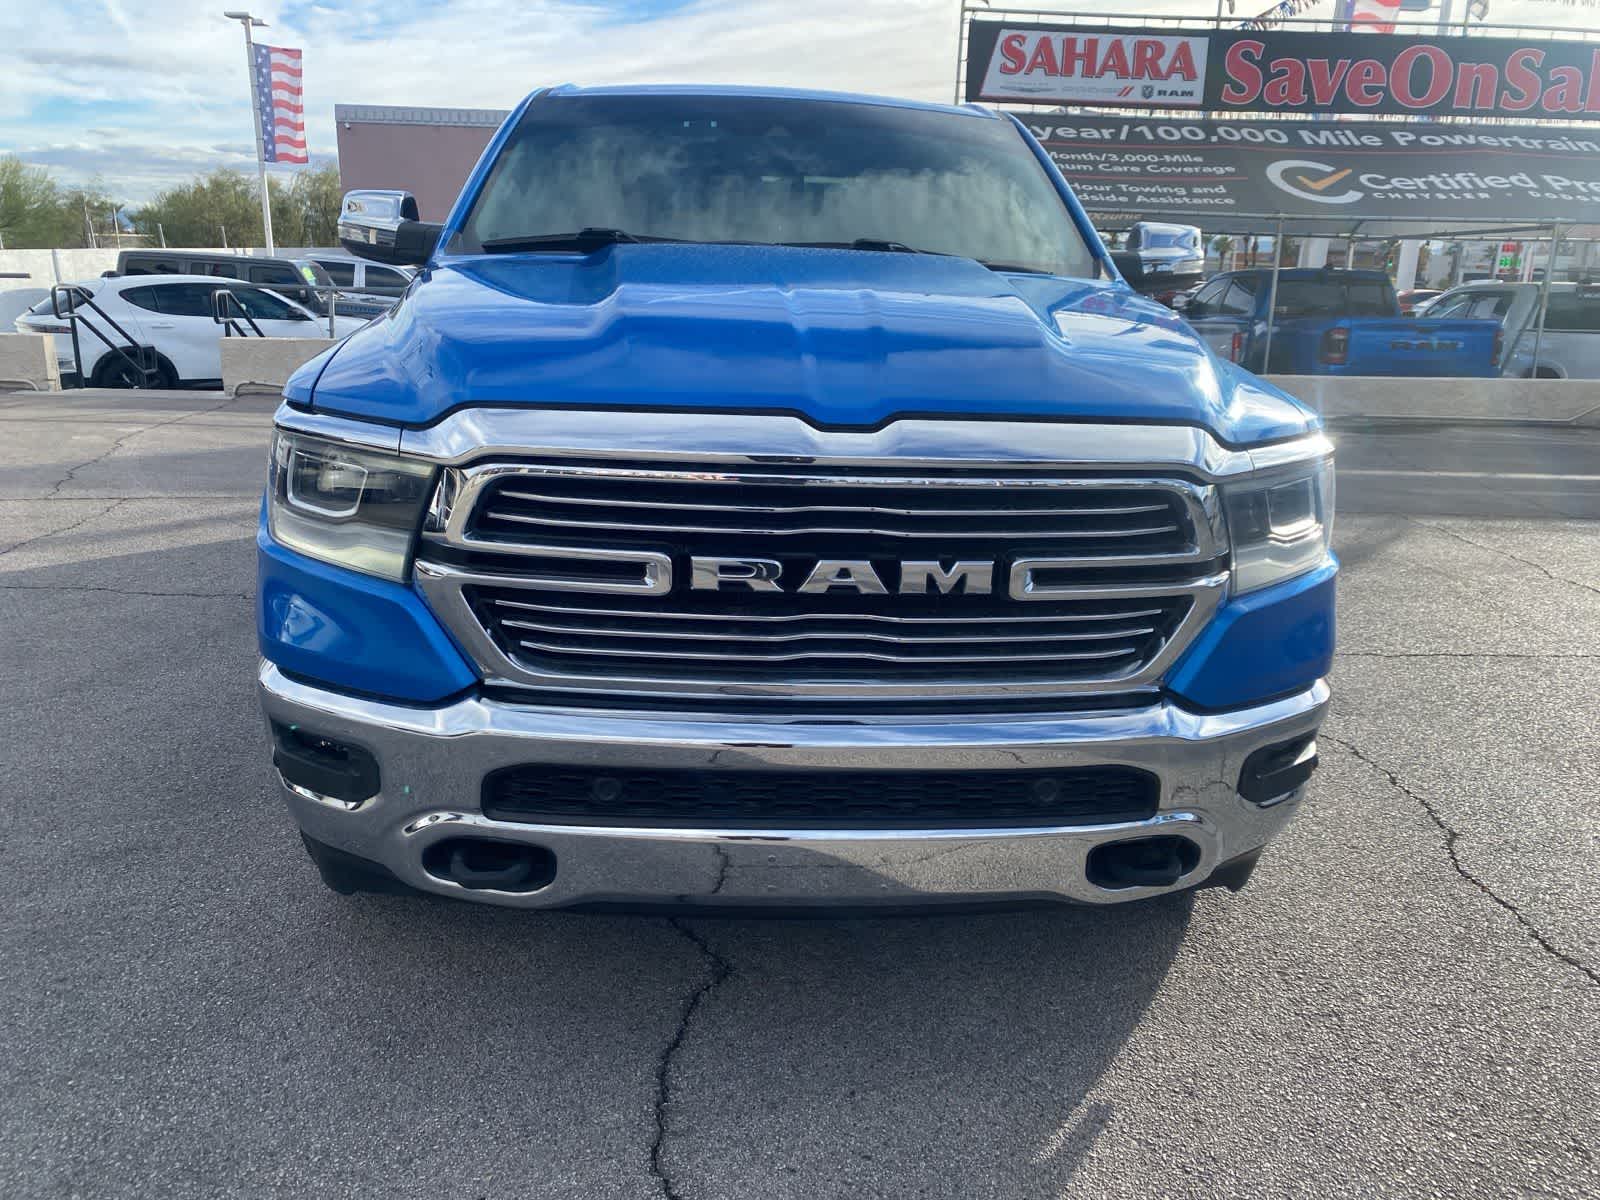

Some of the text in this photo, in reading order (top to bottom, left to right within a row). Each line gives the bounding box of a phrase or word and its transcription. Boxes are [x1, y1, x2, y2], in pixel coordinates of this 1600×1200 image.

[1000, 33, 1198, 81] SAHARA
[1157, 89, 1194, 97] RAM
[1298, 129, 1384, 146] Mile
[1390, 130, 1600, 152] Powertrain
[1098, 163, 1140, 172] Care
[1147, 163, 1236, 174] Coverage
[1359, 172, 1538, 190] Certified
[1117, 184, 1186, 195] Towing
[1192, 185, 1226, 194] and
[1136, 194, 1236, 205] Assistance
[1373, 192, 1490, 200] CHRYSLER
[690, 556, 995, 594] RAM
